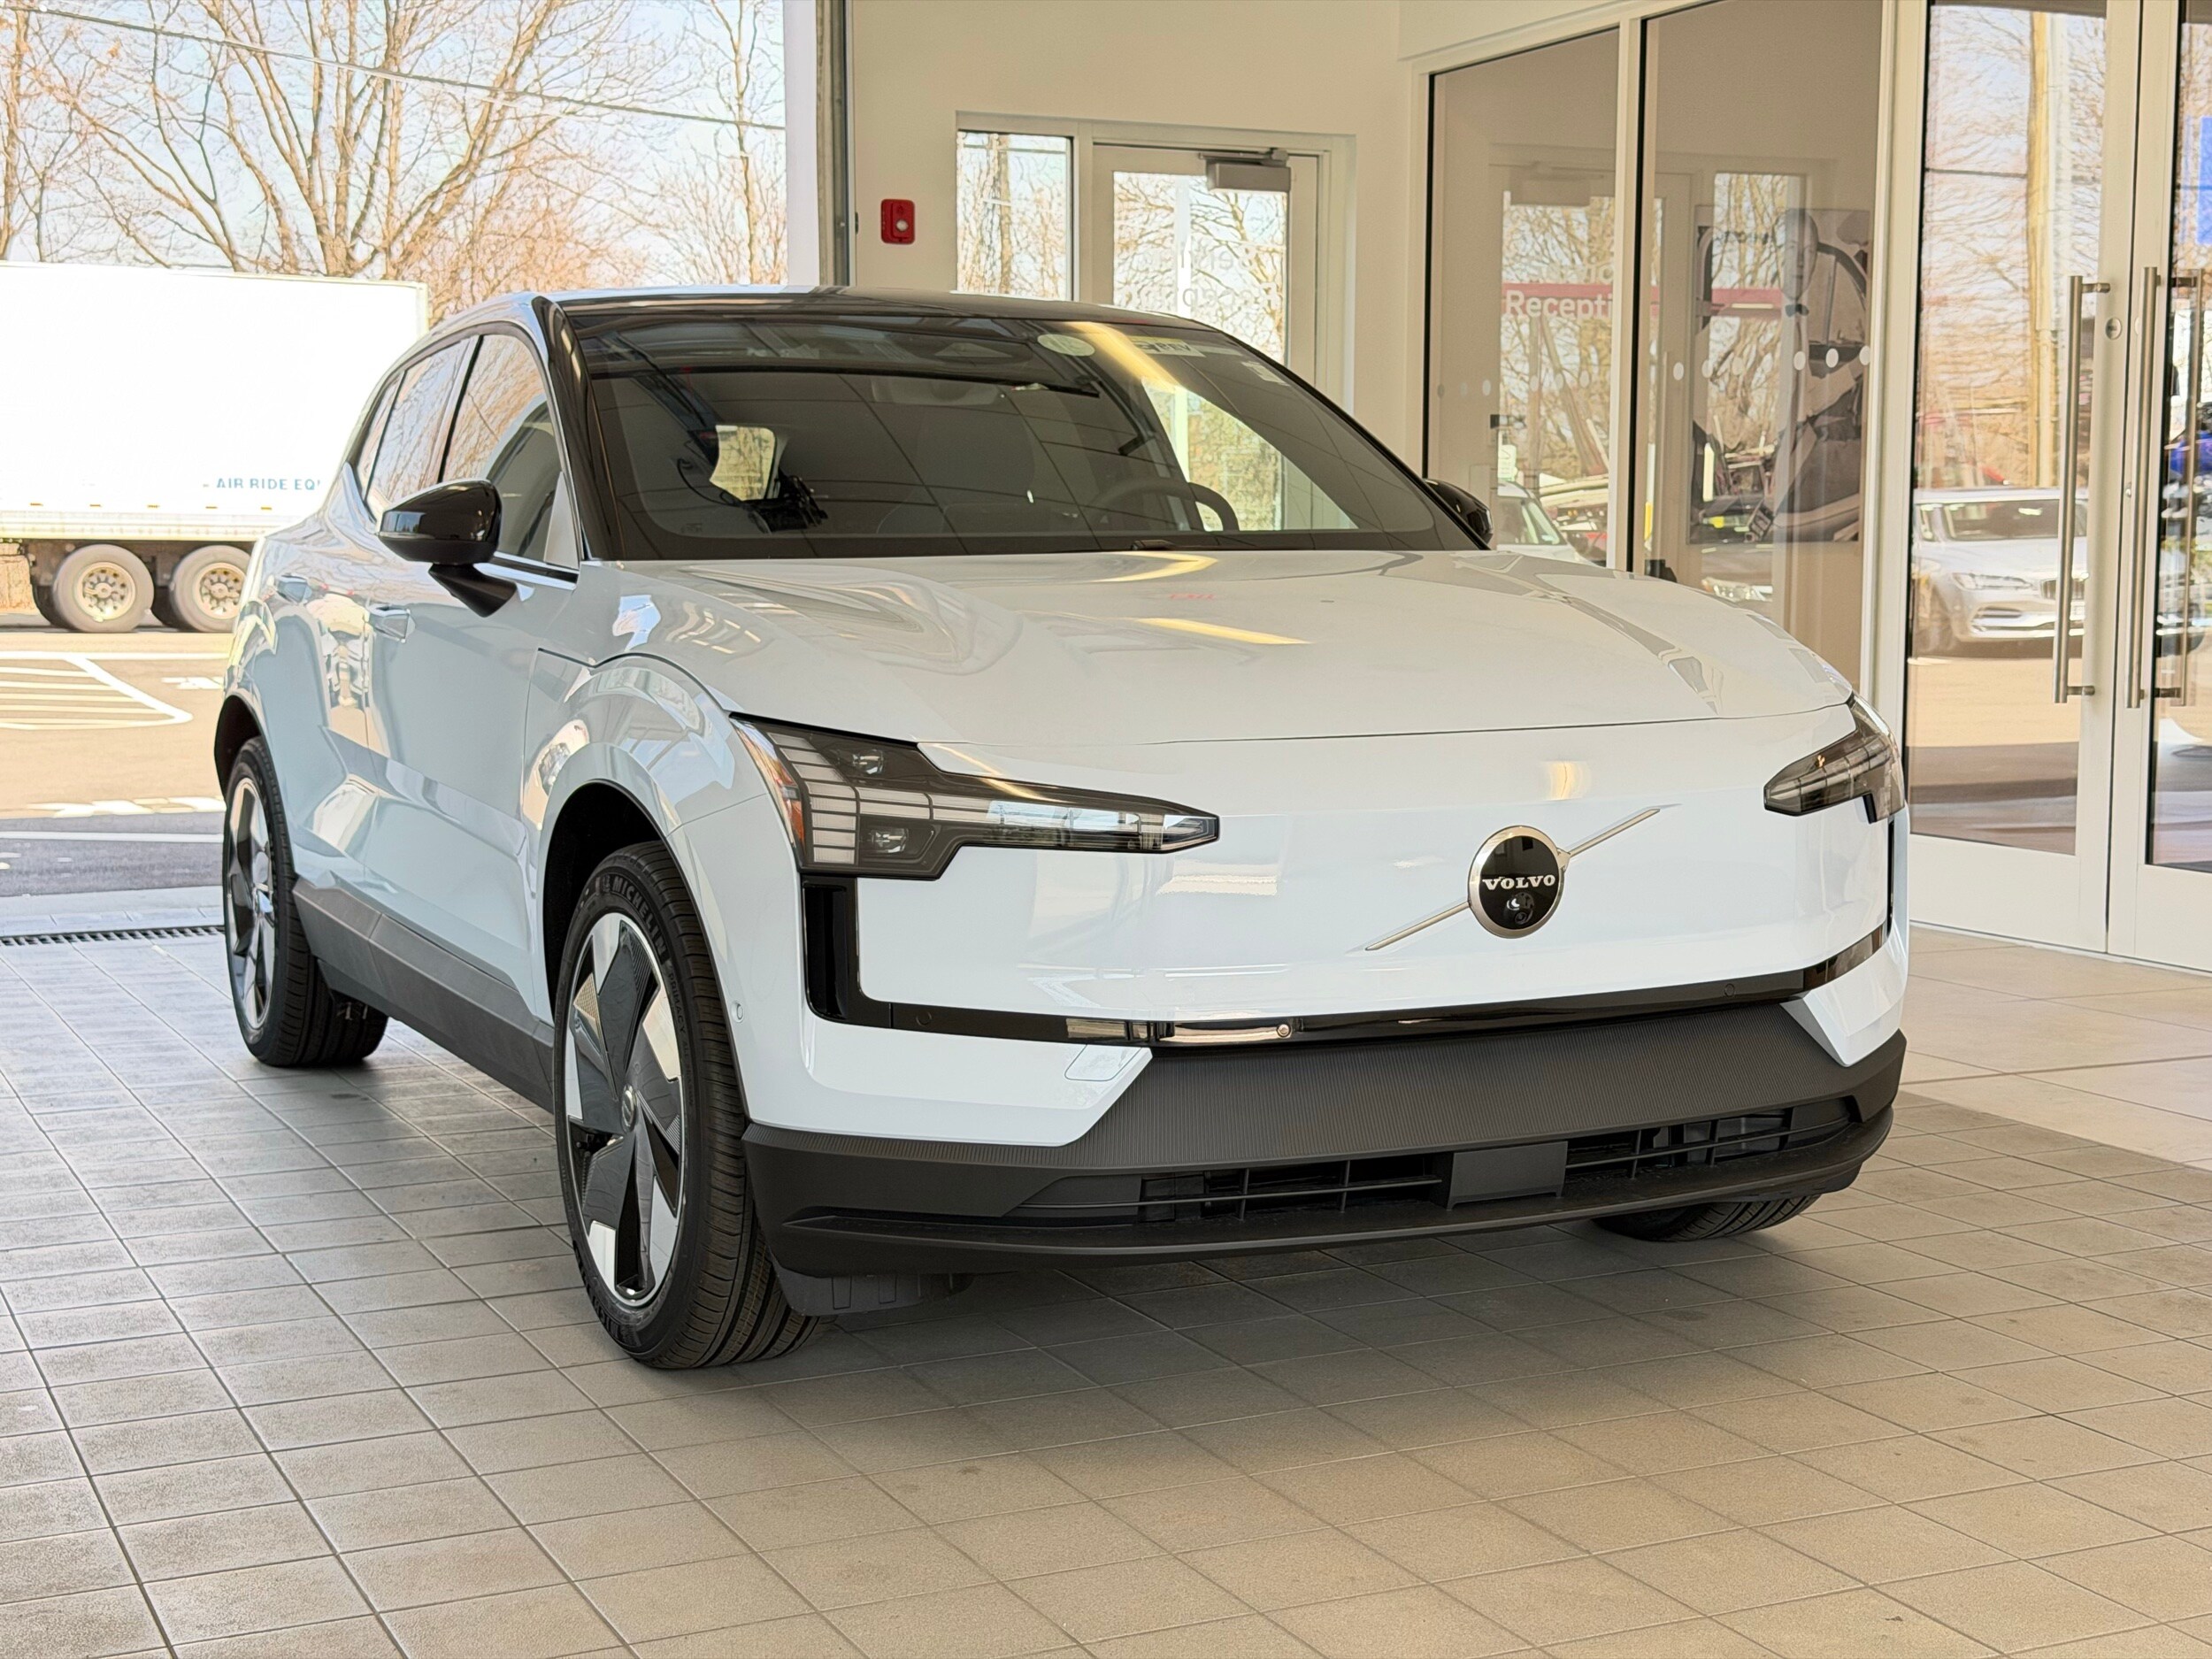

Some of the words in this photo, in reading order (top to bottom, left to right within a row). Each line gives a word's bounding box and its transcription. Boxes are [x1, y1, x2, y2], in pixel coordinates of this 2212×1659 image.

[216, 478, 243, 488] AIR
[250, 478, 288, 490] RIDE
[1482, 874, 1555, 890] VOLVO
[612, 876, 667, 955] MICHELIN
[668, 973, 686, 1033] PRIMACY
